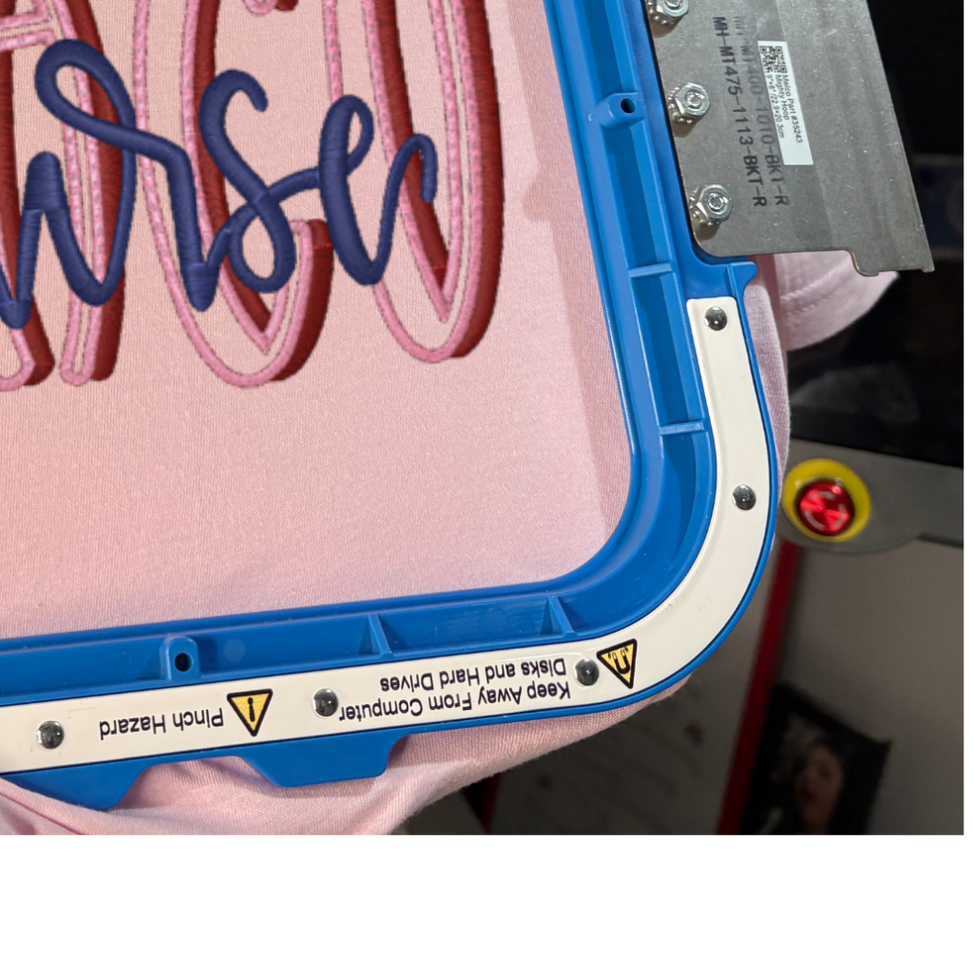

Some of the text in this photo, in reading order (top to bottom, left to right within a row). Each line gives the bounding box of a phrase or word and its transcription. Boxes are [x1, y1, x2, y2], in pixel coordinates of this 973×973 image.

[712, 16, 767, 207] MH-MT475-1113-BKT-R
[775, 74, 789, 121] Mighty Hoop
[782, 74, 791, 97] Melco
[787, 98, 796, 114] Part
[380, 658, 566, 692] Disks and Hard Drives
[338, 681, 571, 721] Keep Away From Computer
[99, 706, 224, 740] Pinch Hazard
